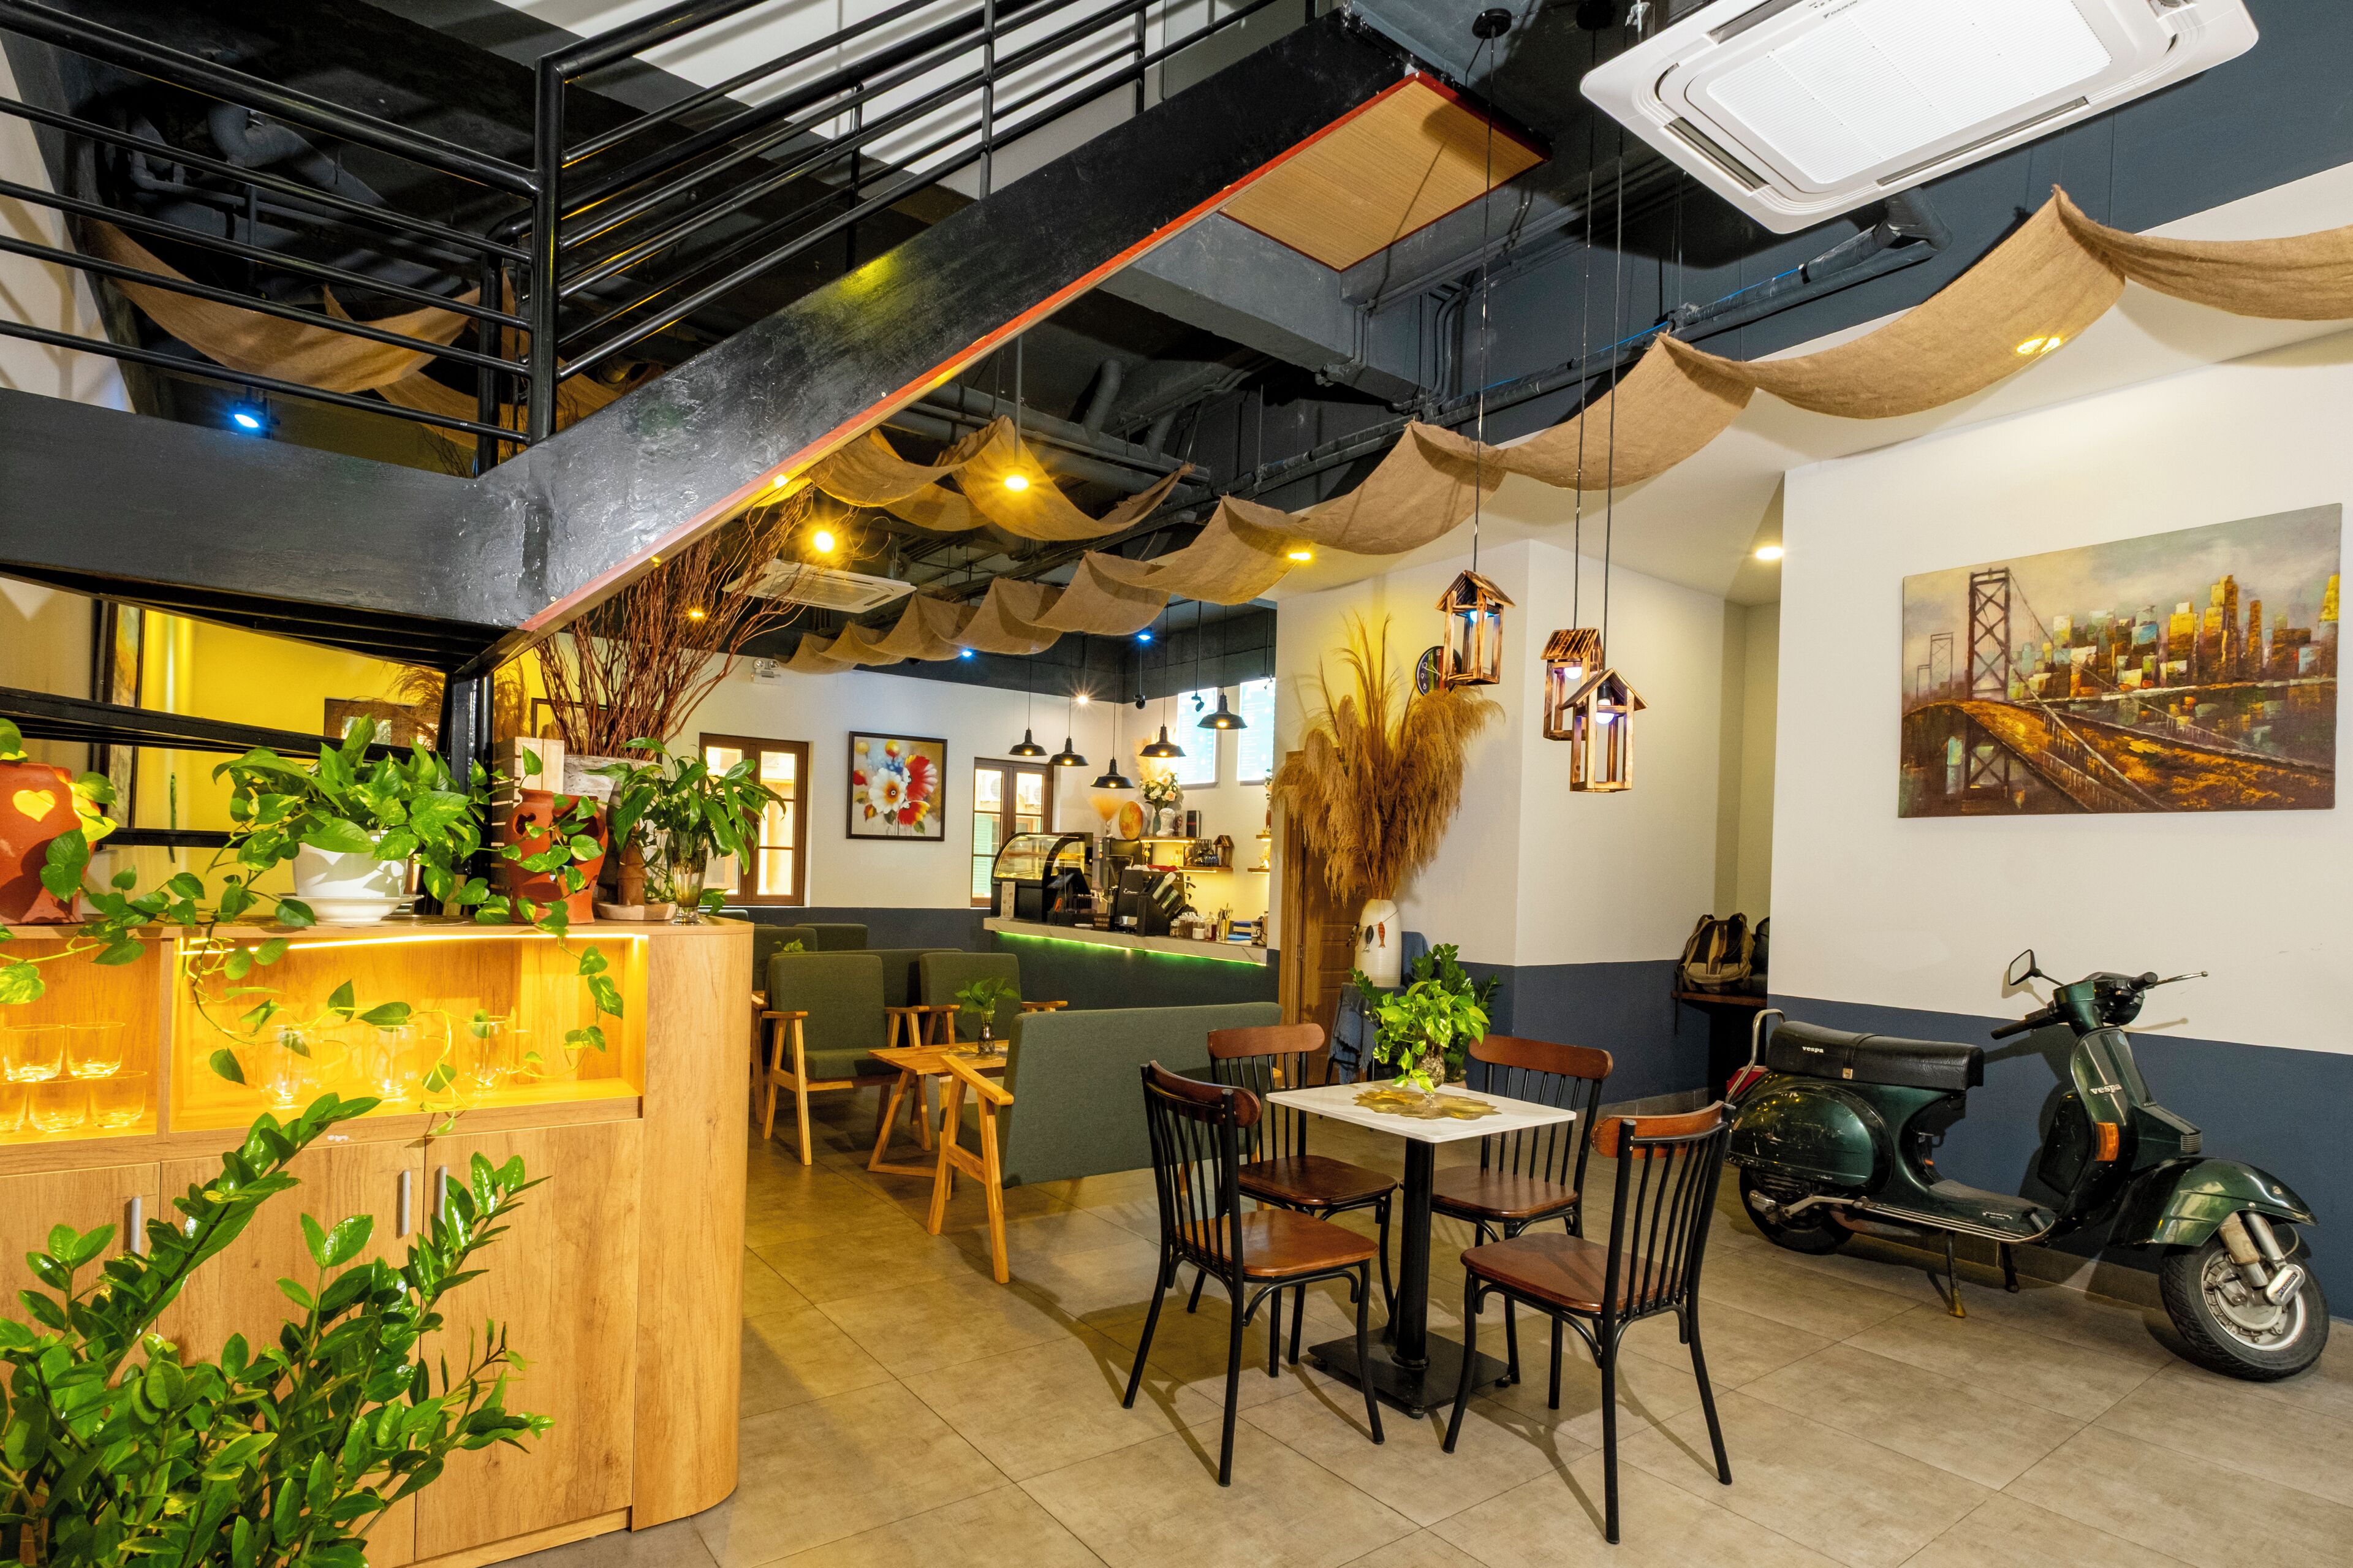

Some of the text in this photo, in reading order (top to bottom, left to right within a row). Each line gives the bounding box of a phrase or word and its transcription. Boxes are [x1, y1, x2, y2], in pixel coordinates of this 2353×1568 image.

[1831, 0, 1858, 15] DAIKIN
[2090, 1084, 2122, 1094] vespa
[2278, 1274, 2297, 1296] PIAGGIO
